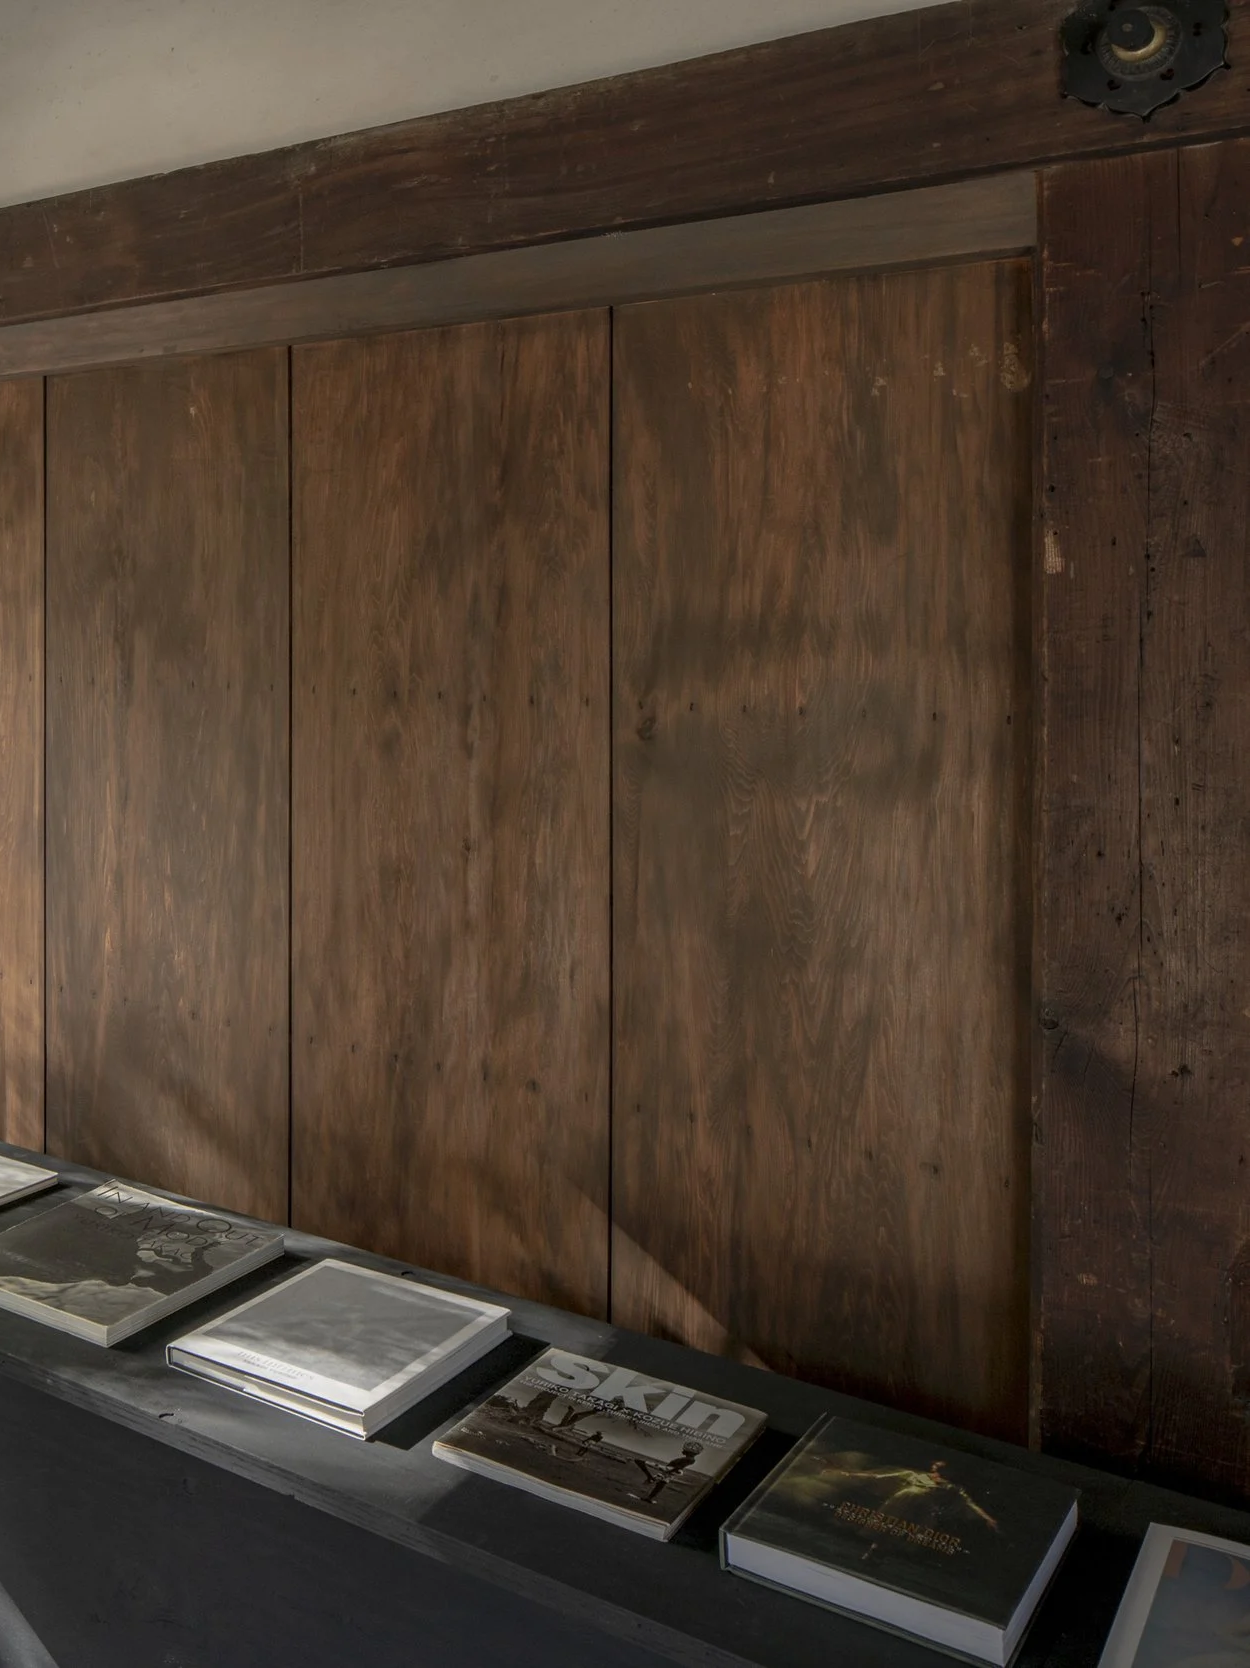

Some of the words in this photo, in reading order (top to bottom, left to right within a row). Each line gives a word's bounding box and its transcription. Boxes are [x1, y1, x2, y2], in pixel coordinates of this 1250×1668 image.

[97, 1186, 133, 1204] IN
[127, 1202, 191, 1224] AND
[196, 1218, 266, 1246] OUT
[522, 1376, 570, 1394] YURIKO
[572, 1390, 622, 1411] TAKAGI
[633, 1410, 680, 1431] KOZUE
[680, 1426, 727, 1444] HIBINO
[839, 1501, 921, 1533] CHRISTIAN
[924, 1528, 962, 1547] DIOR
